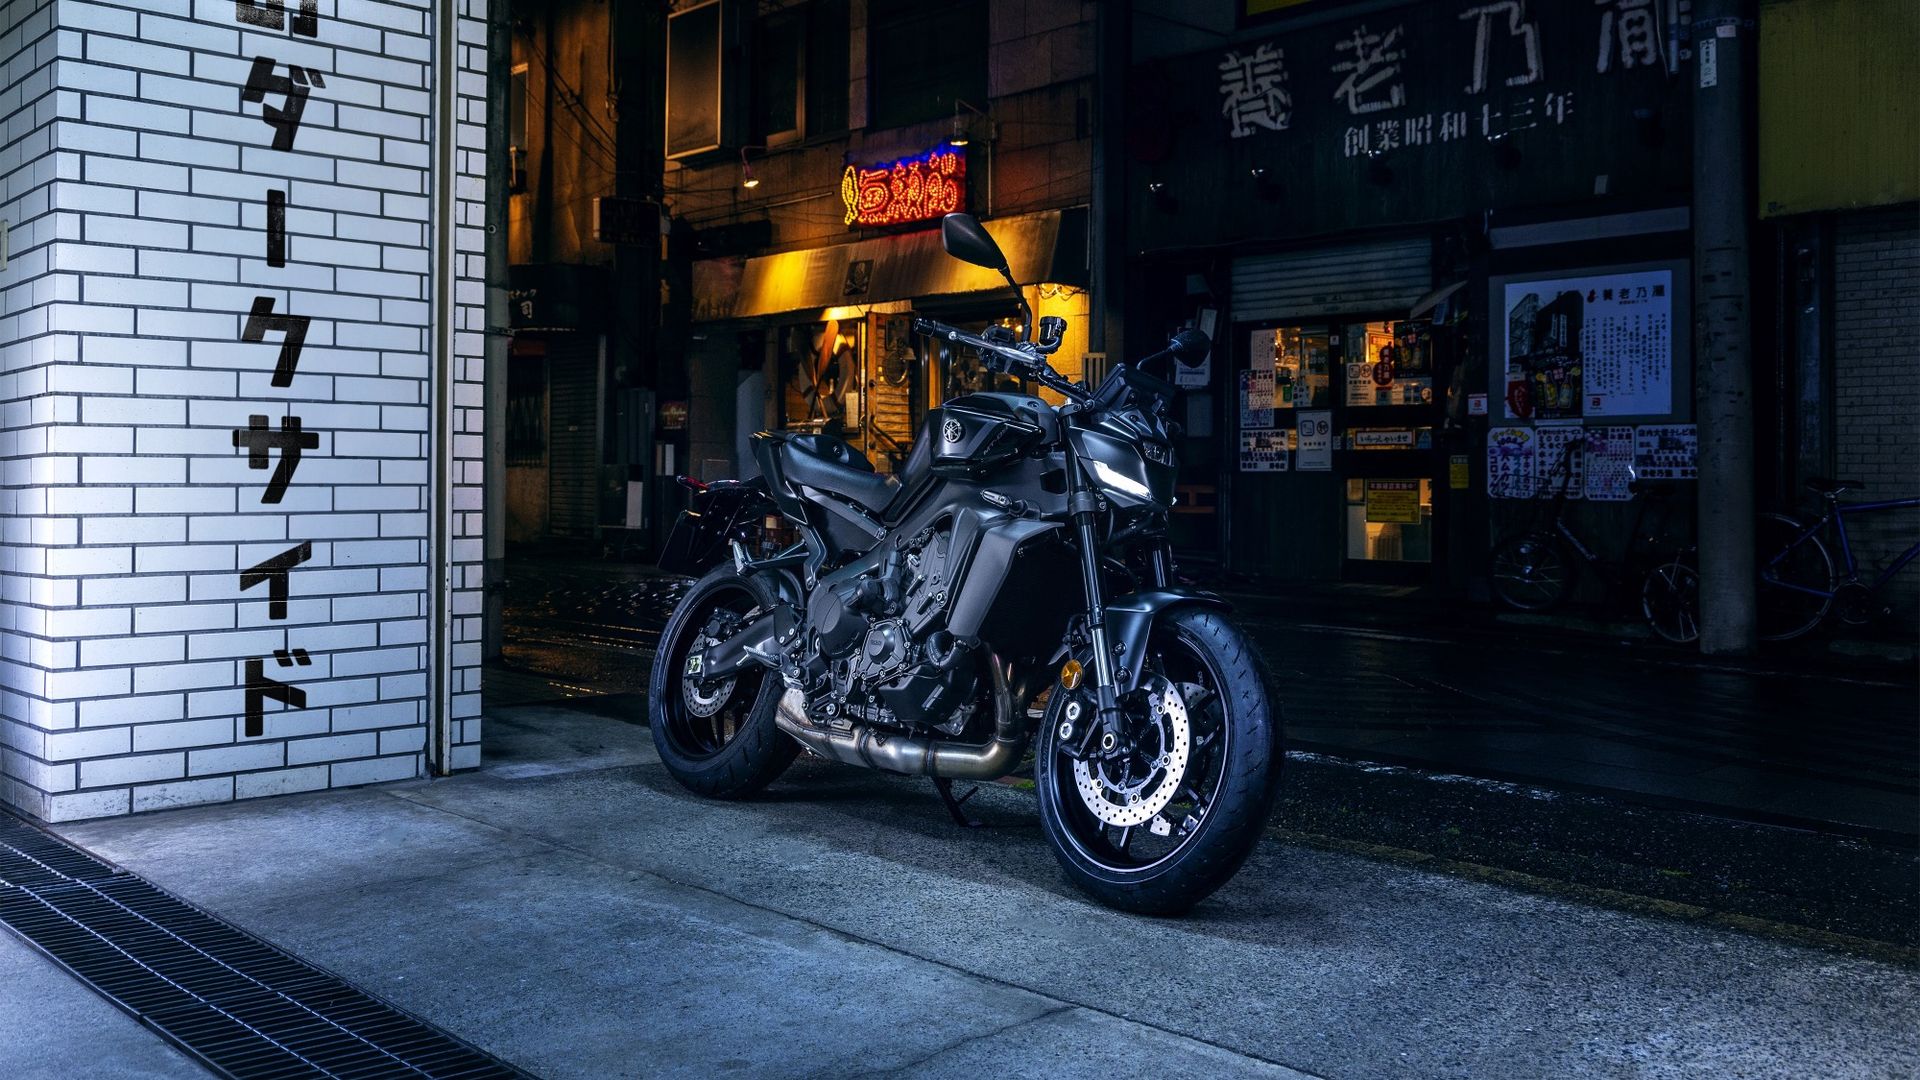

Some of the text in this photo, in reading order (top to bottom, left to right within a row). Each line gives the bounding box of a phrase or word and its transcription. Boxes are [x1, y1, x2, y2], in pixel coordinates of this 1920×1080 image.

[1343, 91, 1577, 158] 創業昭和十三年
